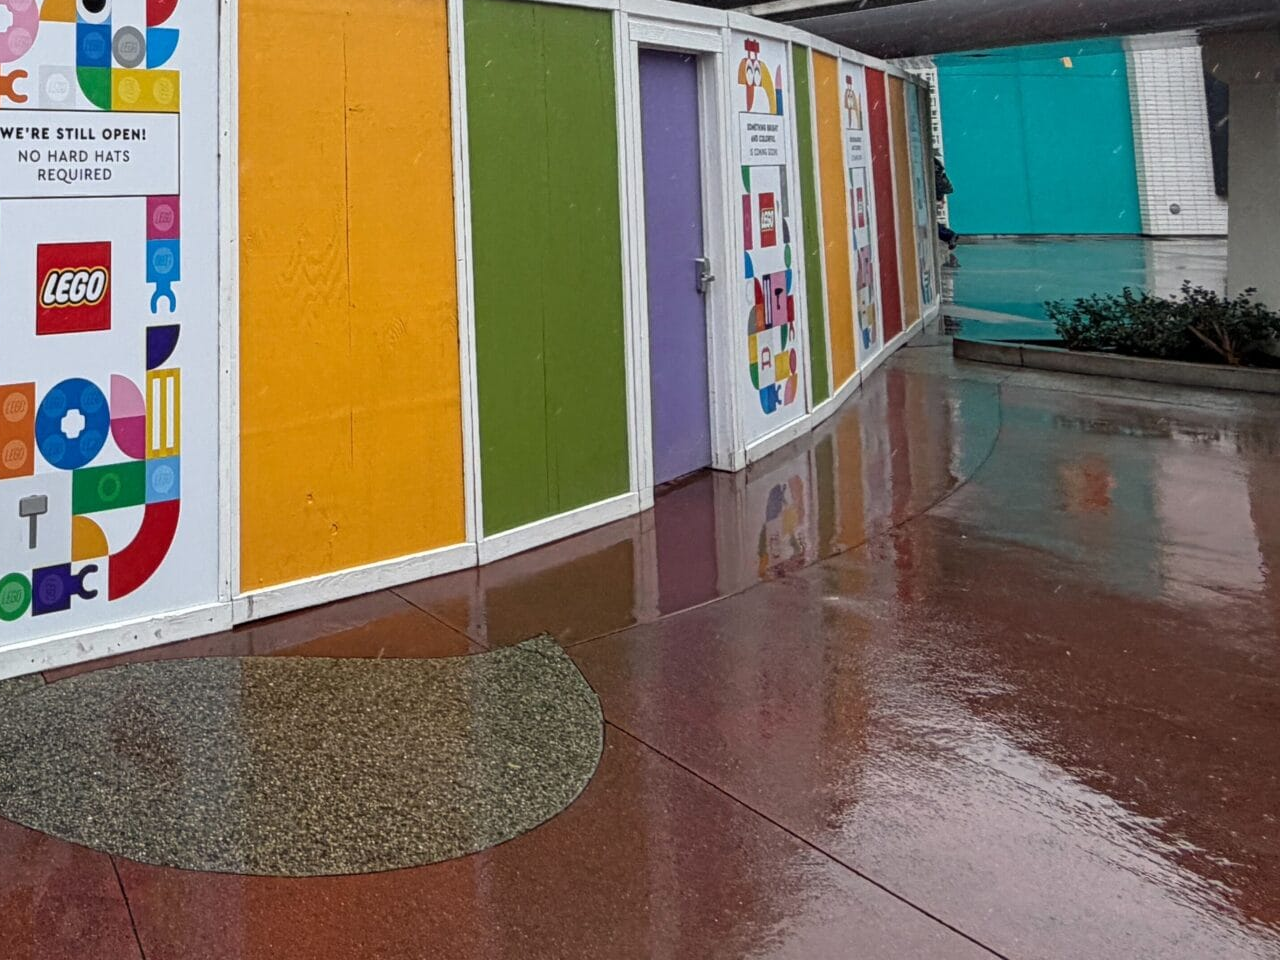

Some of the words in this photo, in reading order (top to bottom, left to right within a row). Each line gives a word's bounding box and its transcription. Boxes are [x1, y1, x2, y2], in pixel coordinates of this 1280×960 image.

[0, 127, 49, 139] WE'RE
[56, 127, 96, 140] STILL
[102, 128, 146, 140] OPEN!
[18, 149, 41, 162] NO
[48, 150, 89, 162] HARD
[95, 150, 130, 163] HATS
[38, 168, 112, 184] REQUIRED
[41, 268, 107, 306] LEGO
